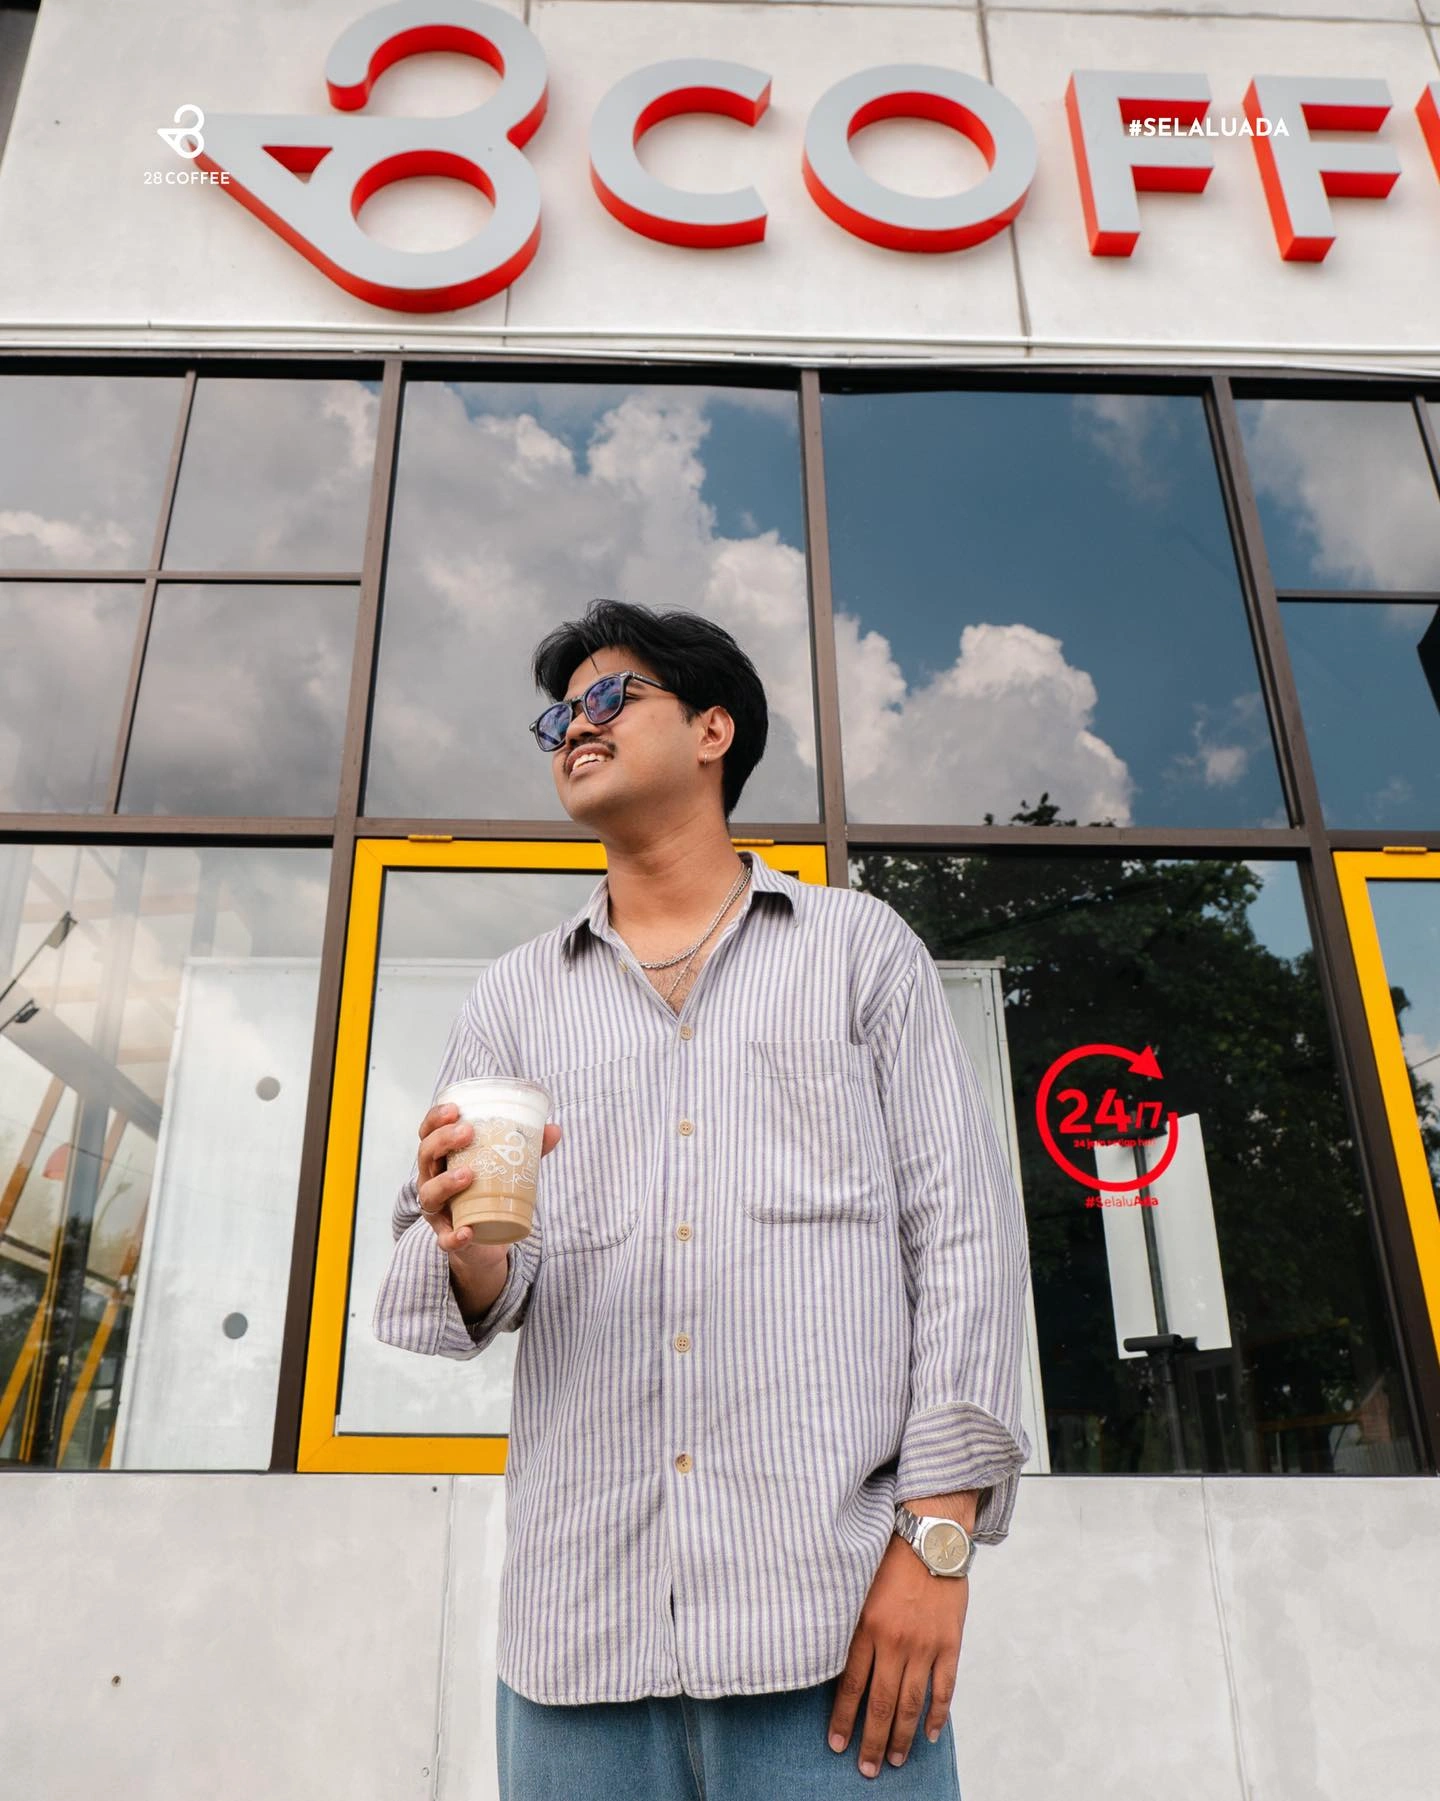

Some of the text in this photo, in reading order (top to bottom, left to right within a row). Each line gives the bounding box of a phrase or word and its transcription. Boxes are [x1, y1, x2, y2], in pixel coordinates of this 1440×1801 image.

[590, 57, 1440, 262] COFF
[1056, 1088, 1163, 1133] 24/7
[1085, 1195, 1159, 1208] #SelaluAda
